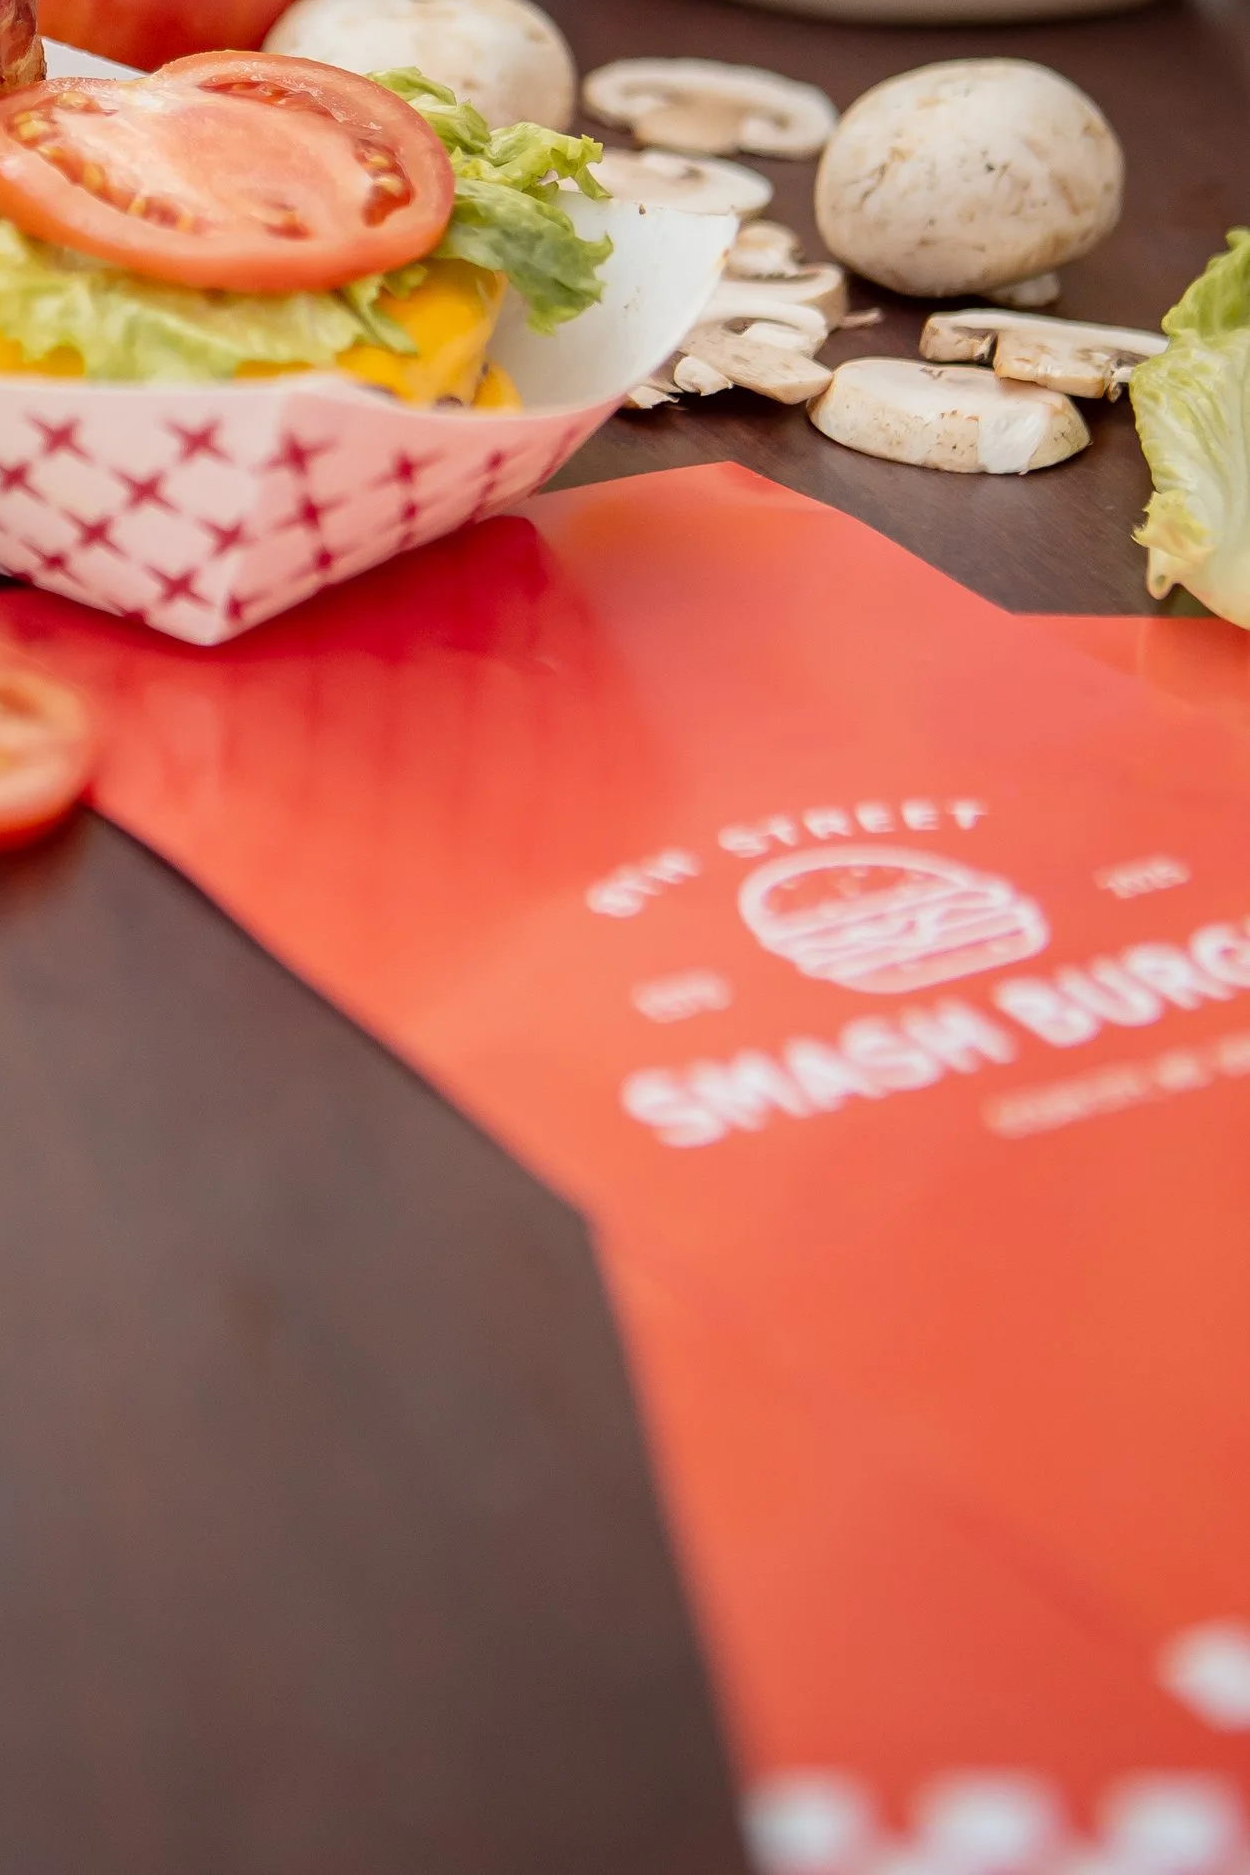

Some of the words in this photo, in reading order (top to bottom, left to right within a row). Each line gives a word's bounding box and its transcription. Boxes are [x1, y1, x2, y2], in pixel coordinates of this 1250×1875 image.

[718, 797, 988, 858] STREET
[620, 995, 1020, 1150] SMASH
[990, 917, 1250, 1049] BURG
